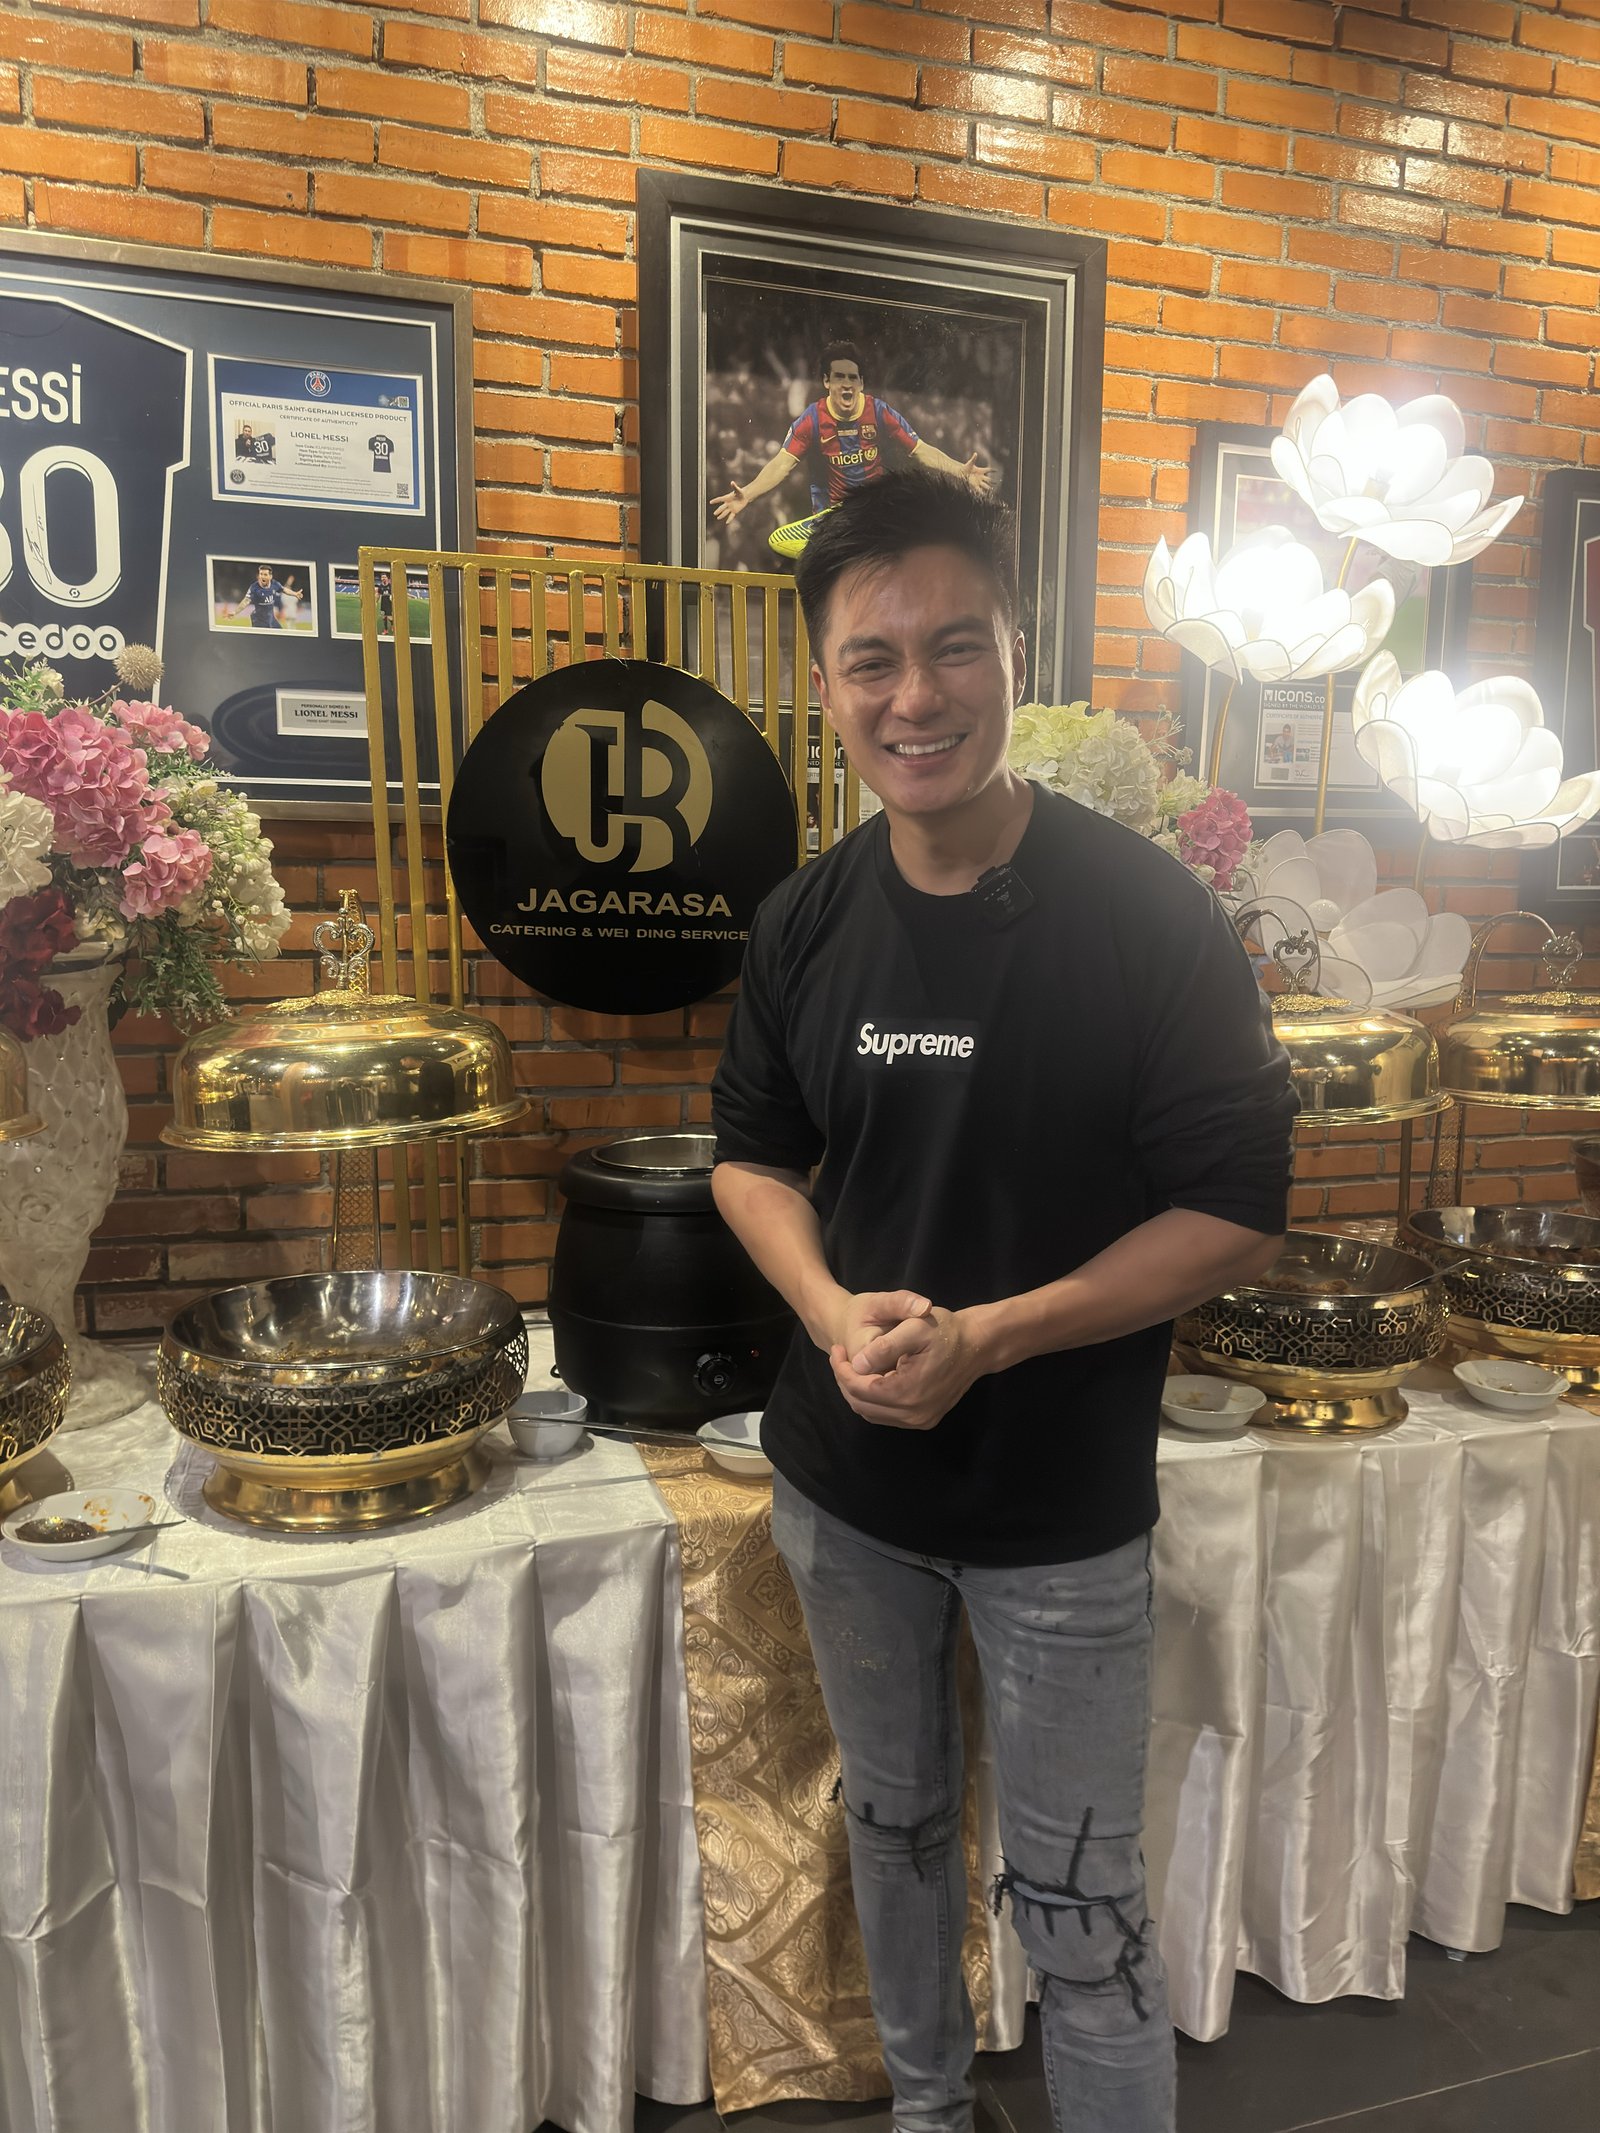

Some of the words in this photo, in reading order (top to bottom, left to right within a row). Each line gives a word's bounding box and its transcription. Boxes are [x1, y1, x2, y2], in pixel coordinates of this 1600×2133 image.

[229, 400, 261, 409] OFFICIAL
[262, 403, 283, 411] PARIS
[284, 405, 339, 416] SAINT-GERMAIN
[340, 410, 374, 419] LICENSED
[375, 413, 407, 422] PRODUCT
[279, 414, 312, 422] CERTIFICATE
[321, 418, 358, 426] AUTHENTICITY
[290, 431, 321, 441] LIONEL
[322, 434, 349, 443] MESSI
[254, 440, 269, 453] 30
[374, 441, 388, 455] 30
[294, 709, 328, 717] LIONEL
[517, 888, 733, 918] JAGARASA
[489, 924, 577, 938] CATERING
[582, 927, 593, 938] &
[857, 1022, 975, 1065] Supreme
